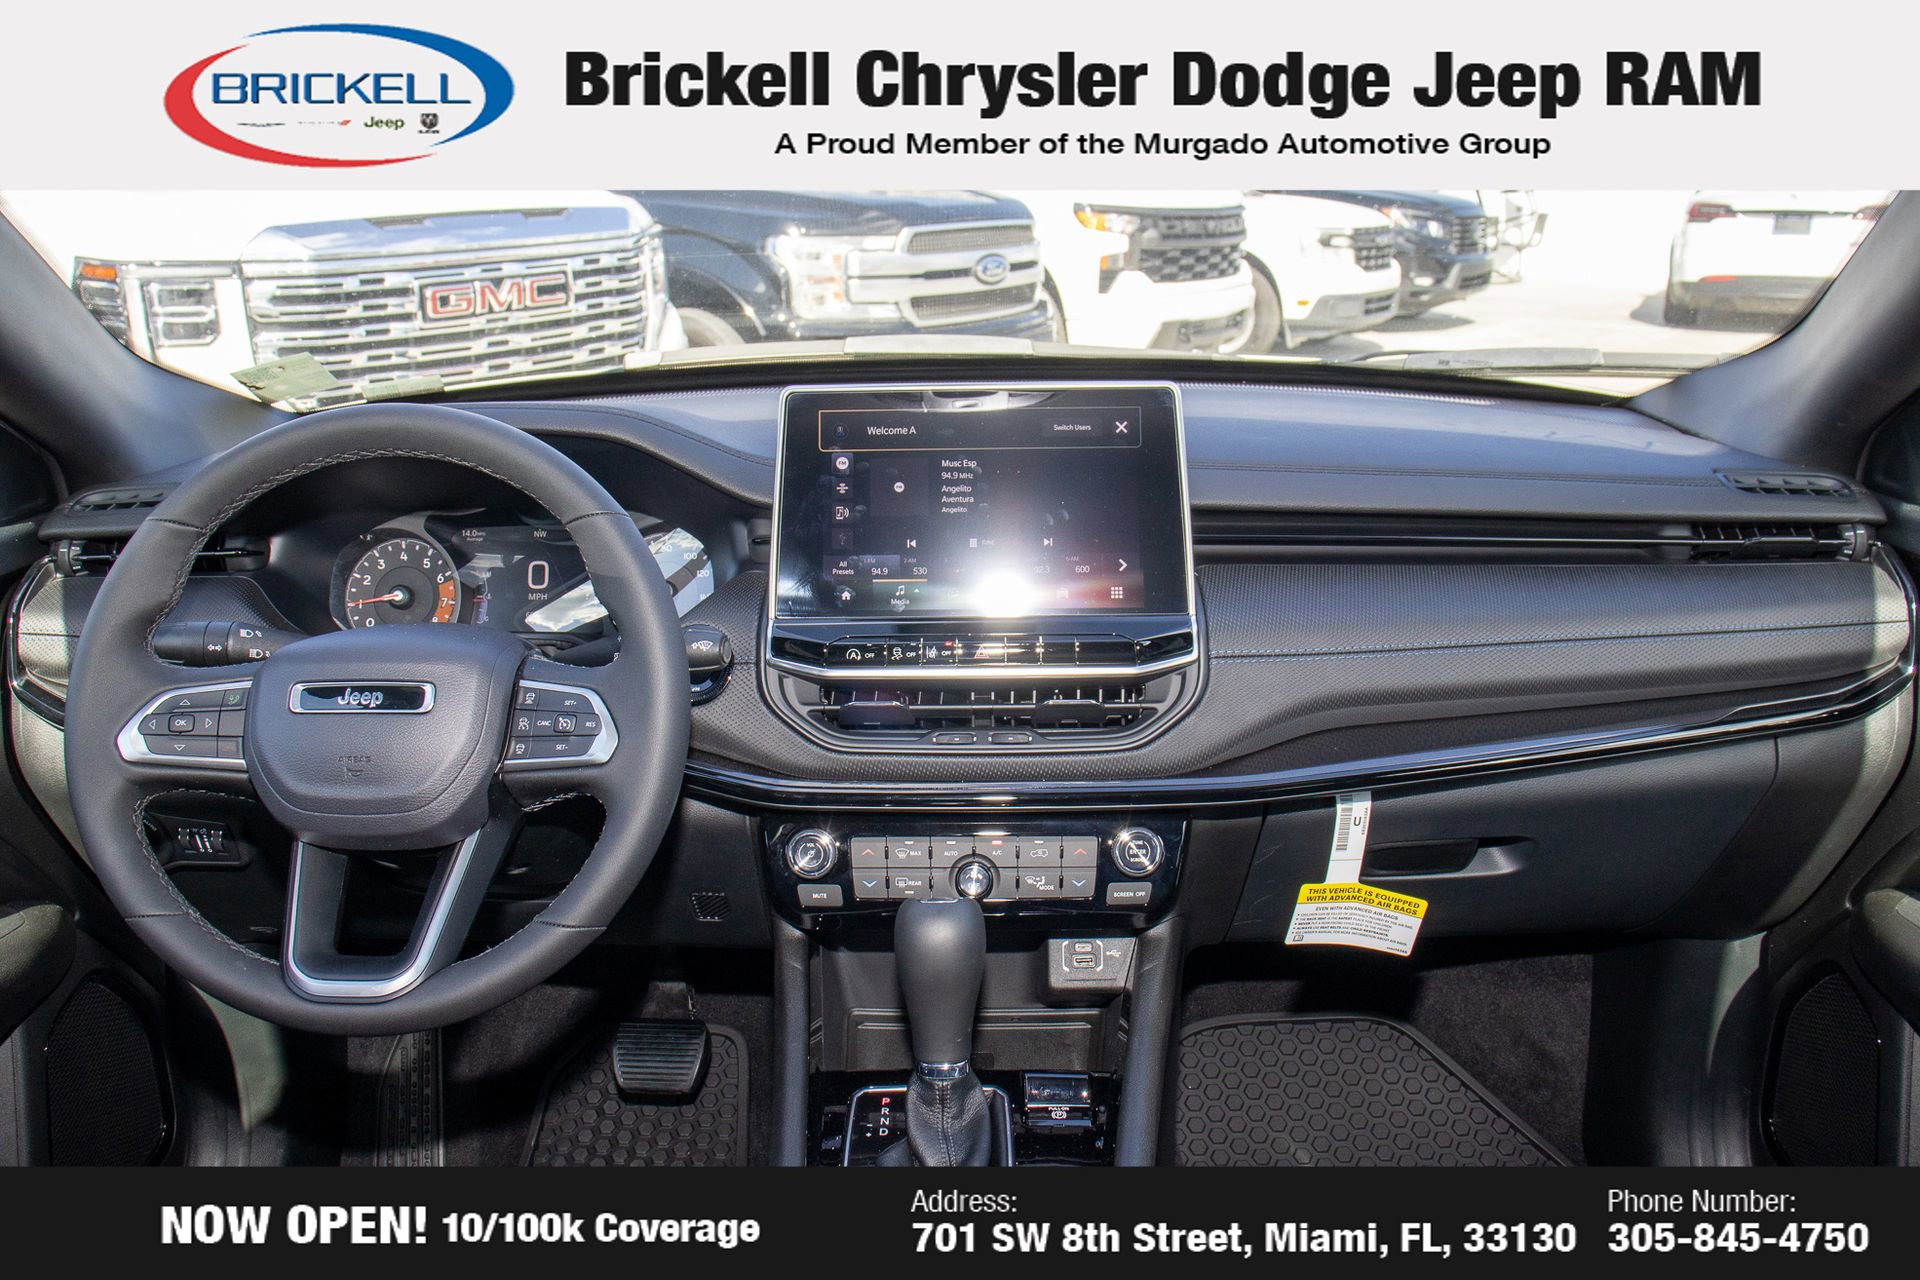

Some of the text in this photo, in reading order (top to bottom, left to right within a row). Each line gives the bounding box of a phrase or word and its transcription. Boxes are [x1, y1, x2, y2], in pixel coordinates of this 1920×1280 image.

[425, 274, 567, 319] GMC
[867, 426, 917, 435] Welcome A
[1053, 423, 1091, 432] Switch Users
[941, 459, 977, 469] Musc Esp
[941, 471, 958, 480] 94.9
[941, 484, 972, 495] Angelito
[941, 495, 975, 504] Aventura
[941, 506, 968, 515] Angelito
[533, 530, 548, 538] NW
[400, 551, 408, 561] 4
[683, 552, 698, 560] 100
[377, 559, 386, 570] 3
[423, 558, 431, 568] 5
[832, 568, 855, 576] Presets
[871, 567, 889, 576] 94.9
[912, 567, 928, 575] 530
[1075, 565, 1090, 573] 600
[528, 561, 549, 589] 0
[363, 575, 372, 585] 2
[441, 597, 448, 607] 7
[365, 617, 375, 627] 0
[337, 688, 384, 708] Jeep
[174, 718, 188, 727] OK
[537, 720, 552, 728] CANC
[1353, 816, 1362, 827] U
[1328, 894, 1375, 905] ADVANCED
[1376, 900, 1392, 909] AIR
[1394, 904, 1418, 916] BAGS
[1375, 892, 1420, 909] EQUIPPED
[881, 1097, 890, 1106] P
[881, 1107, 890, 1115] R
[880, 1117, 890, 1125] N
[879, 1128, 889, 1136] D
